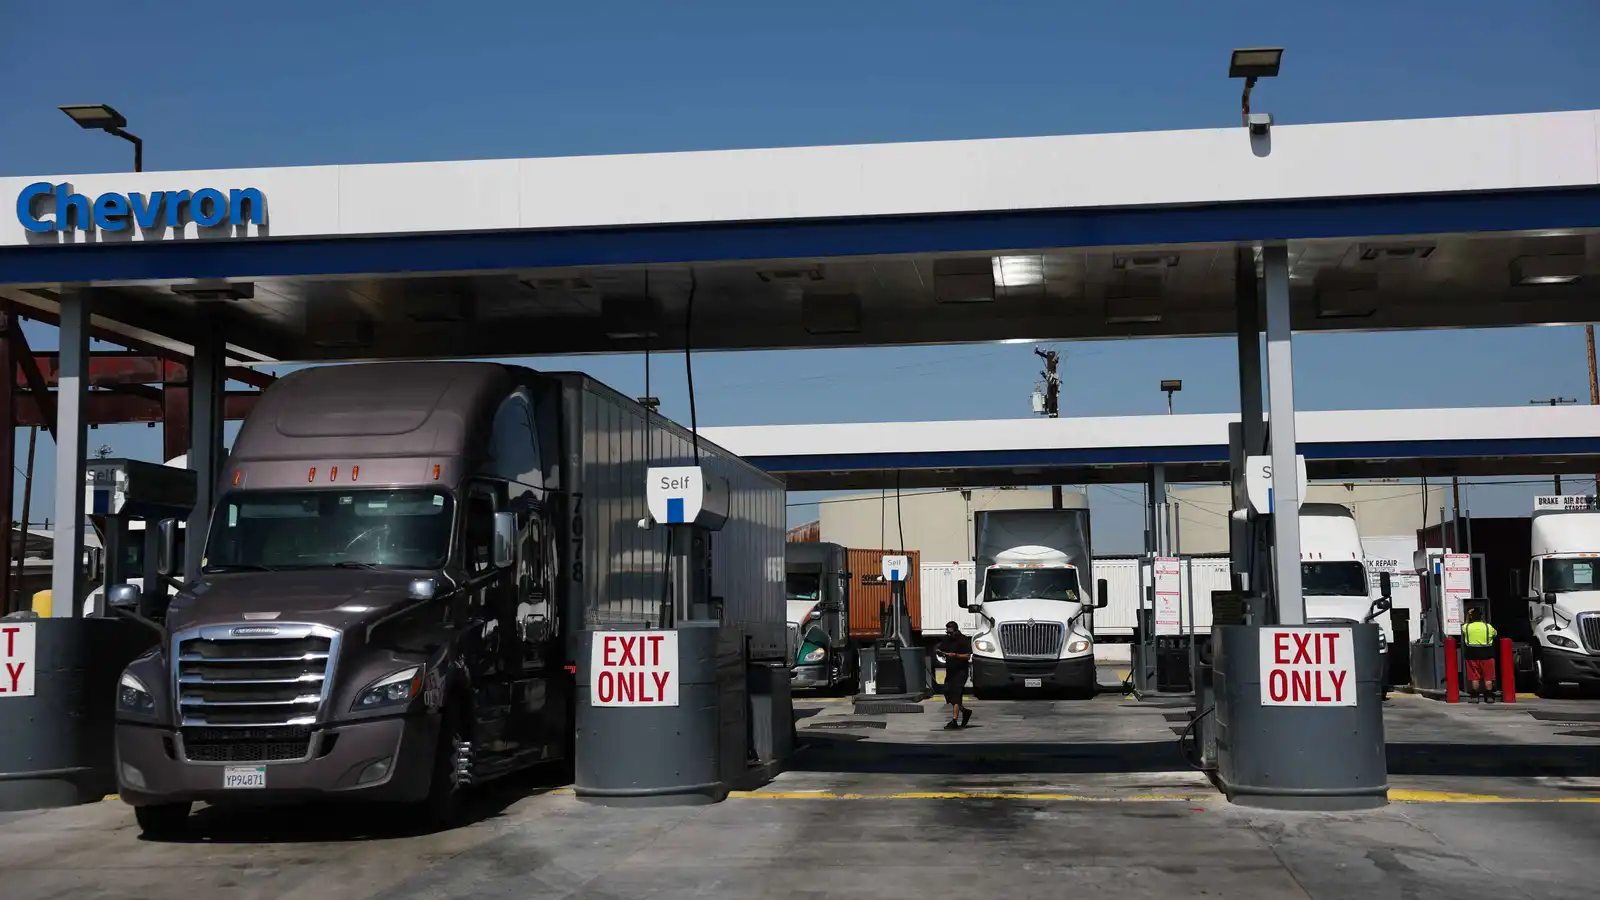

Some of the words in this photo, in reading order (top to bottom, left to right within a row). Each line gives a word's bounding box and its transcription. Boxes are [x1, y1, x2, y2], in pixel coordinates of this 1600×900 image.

[16, 181, 264, 233] Chevron
[88, 469, 116, 481] Self
[660, 476, 690, 490] Self
[1375, 559, 1398, 567] REPAIR
[603, 635, 664, 667] EXIT
[1273, 632, 1340, 665] EXIT
[597, 671, 670, 703] ONLY
[1268, 669, 1347, 702] ONLY
[226, 774, 264, 786] YP94871
